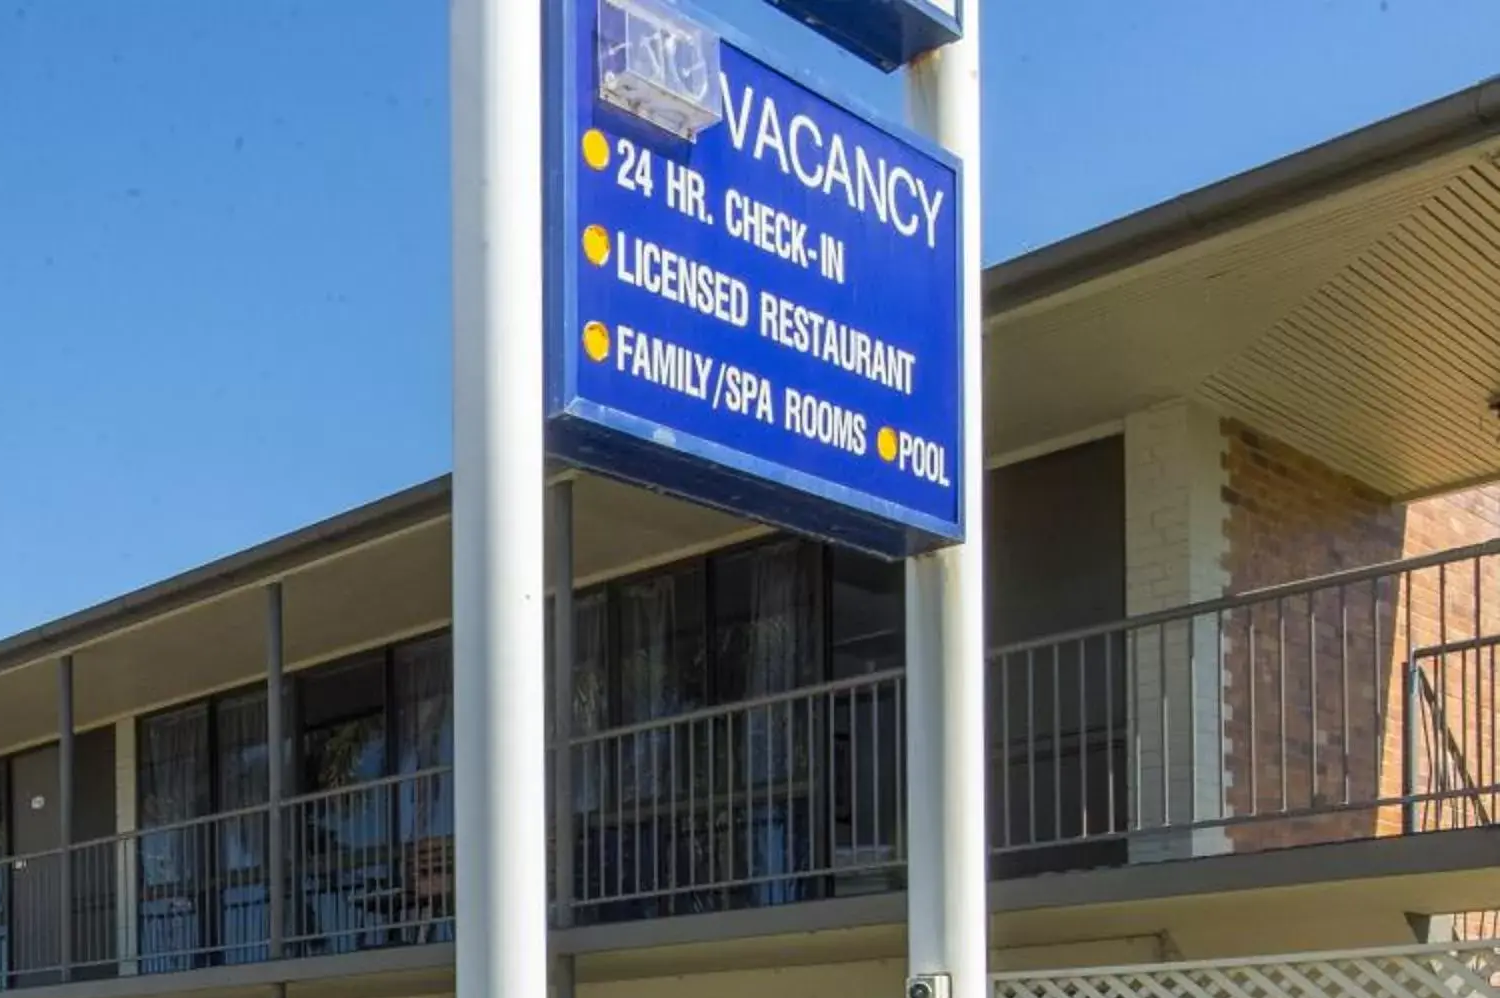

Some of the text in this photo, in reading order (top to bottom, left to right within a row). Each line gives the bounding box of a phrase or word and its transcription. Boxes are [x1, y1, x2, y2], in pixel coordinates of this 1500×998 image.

[617, 138, 845, 284] 24 HR. CHECK-IN
[719, 71, 944, 249] VACANCY
[617, 232, 915, 395] LICENSED RESTAURANT
[784, 395, 867, 456] ROOMS
[899, 431, 949, 487] POOL
